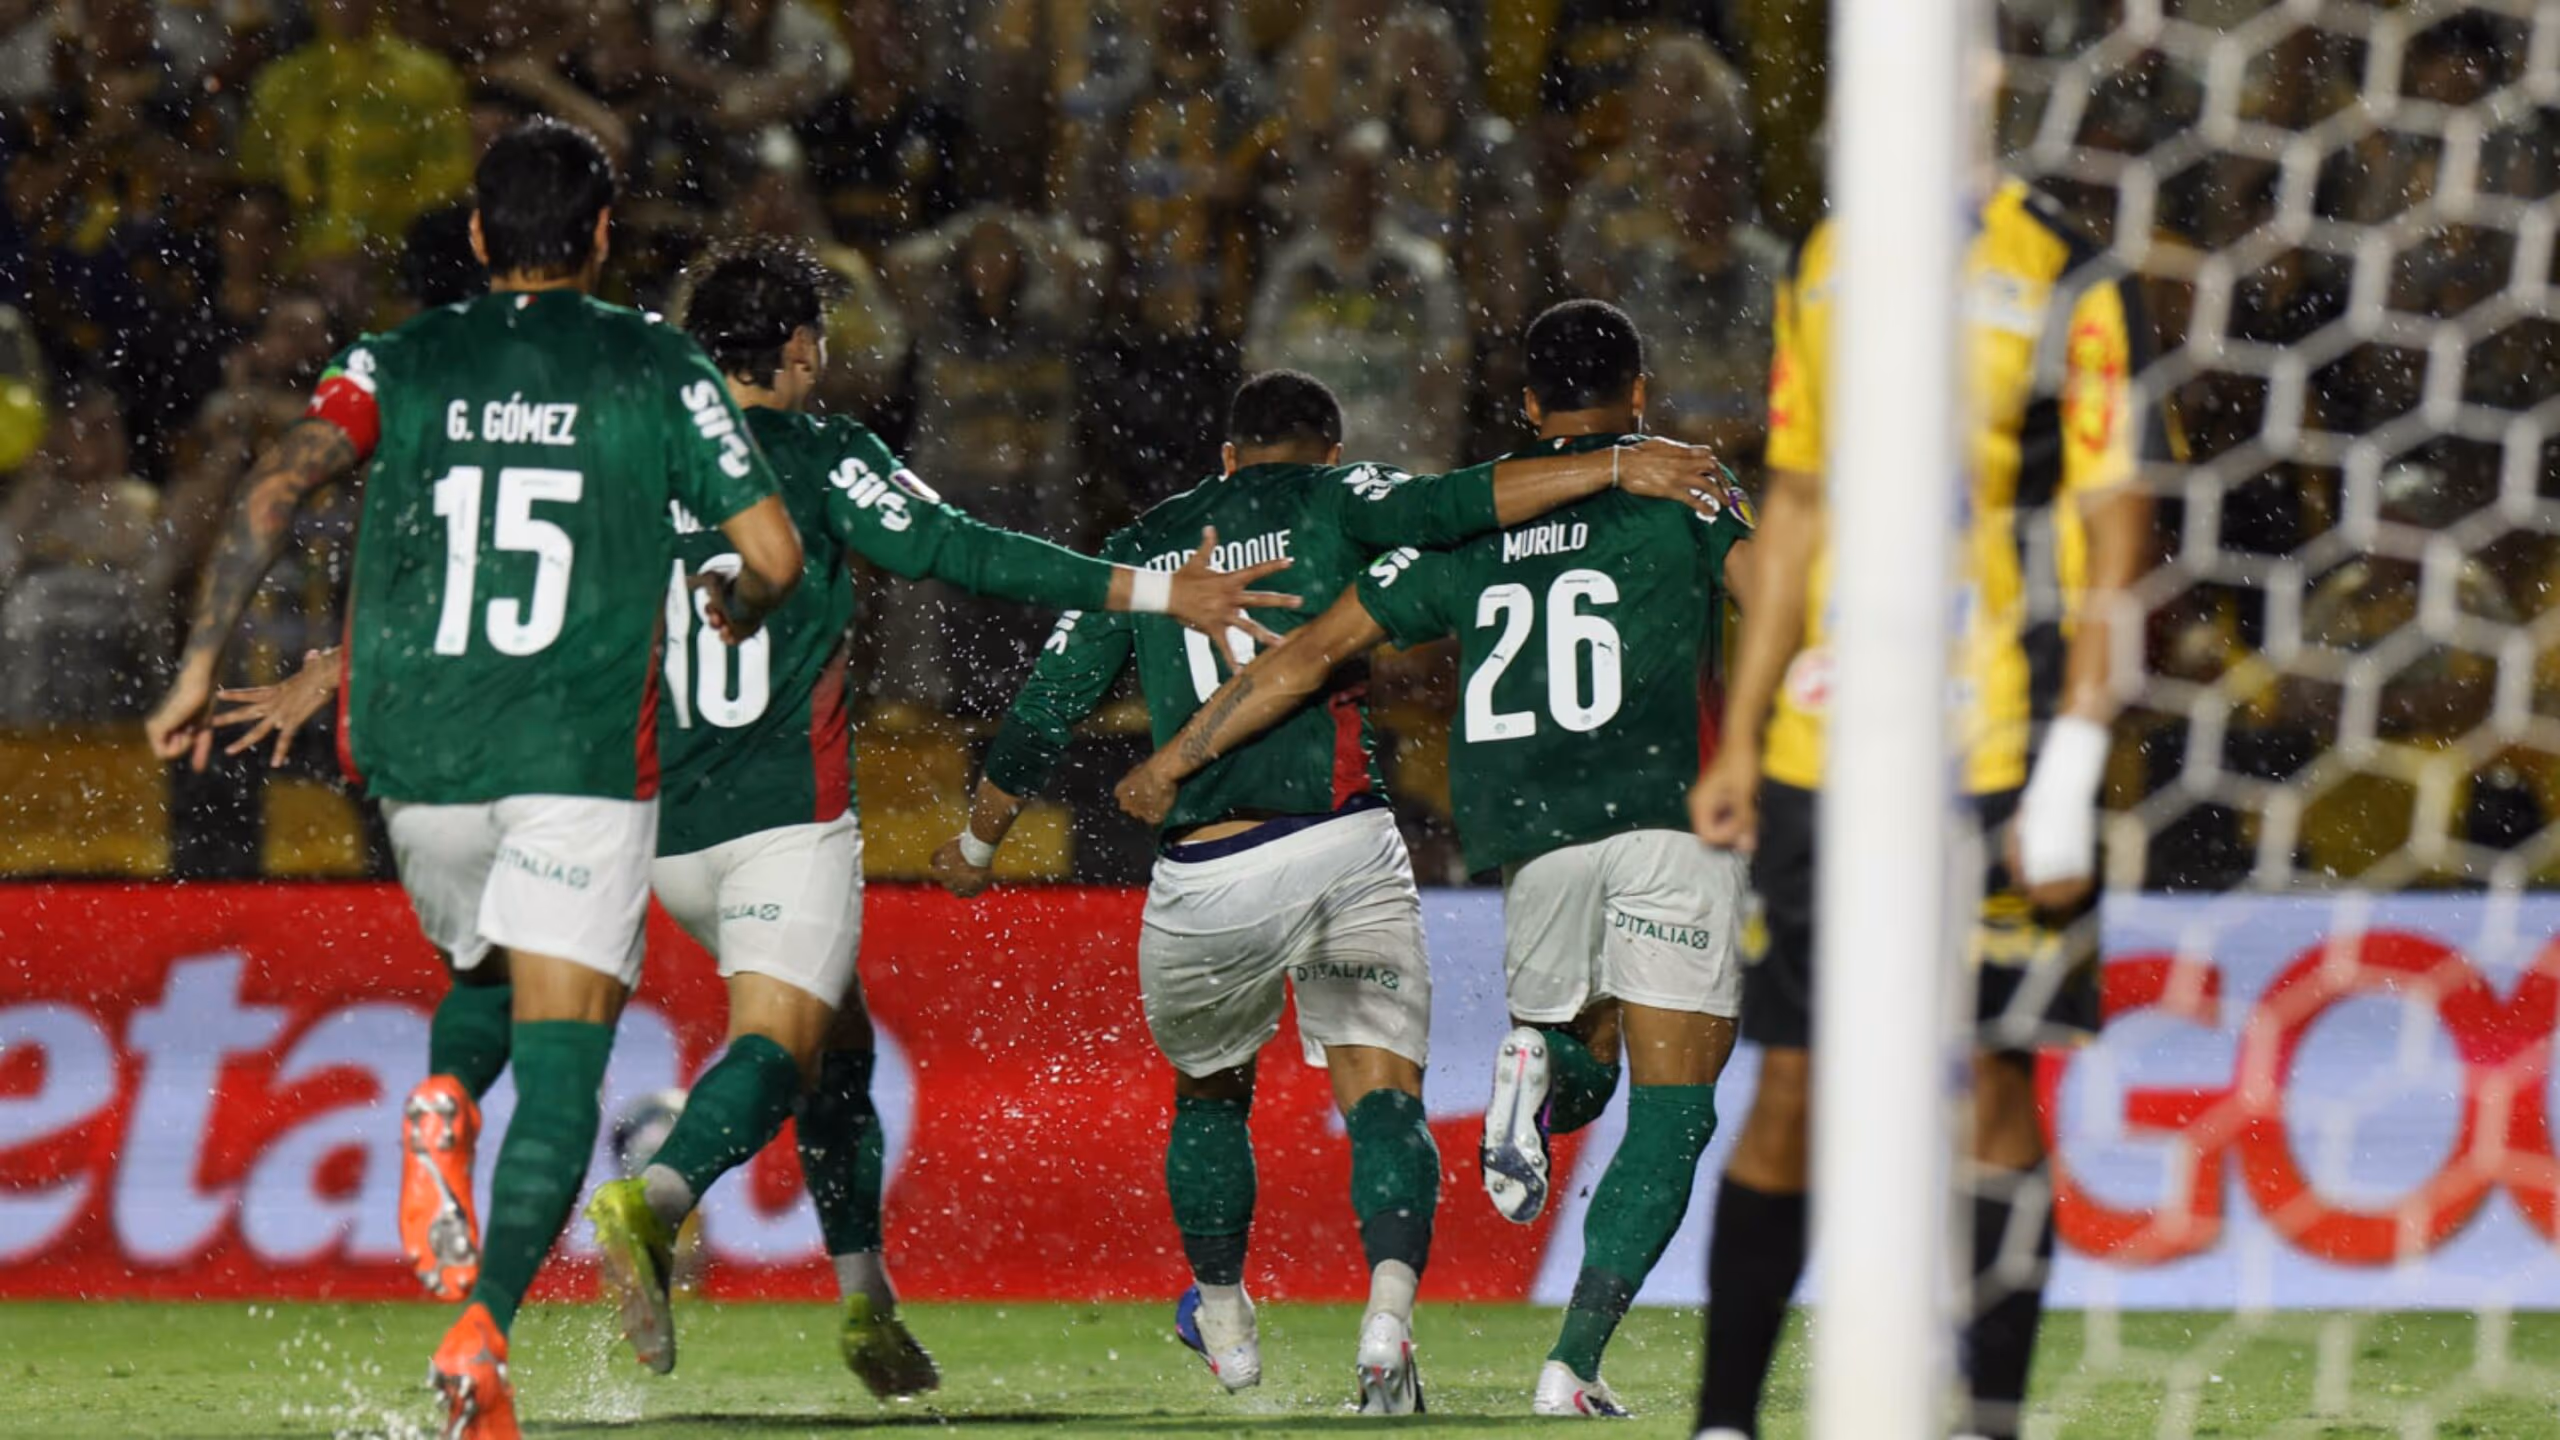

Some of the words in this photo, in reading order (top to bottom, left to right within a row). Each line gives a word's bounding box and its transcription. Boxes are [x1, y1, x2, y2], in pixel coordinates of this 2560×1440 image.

[447, 399, 474, 441] G.
[482, 391, 577, 445] GÓMEZ
[433, 466, 583, 656] 15
[1503, 520, 1588, 564] MURILO
[1465, 568, 1622, 743] 26
[1616, 912, 1689, 946] D'ITALIA
[1297, 962, 1378, 983] D'ITALIA
[2034, 928, 2560, 1266] GO
